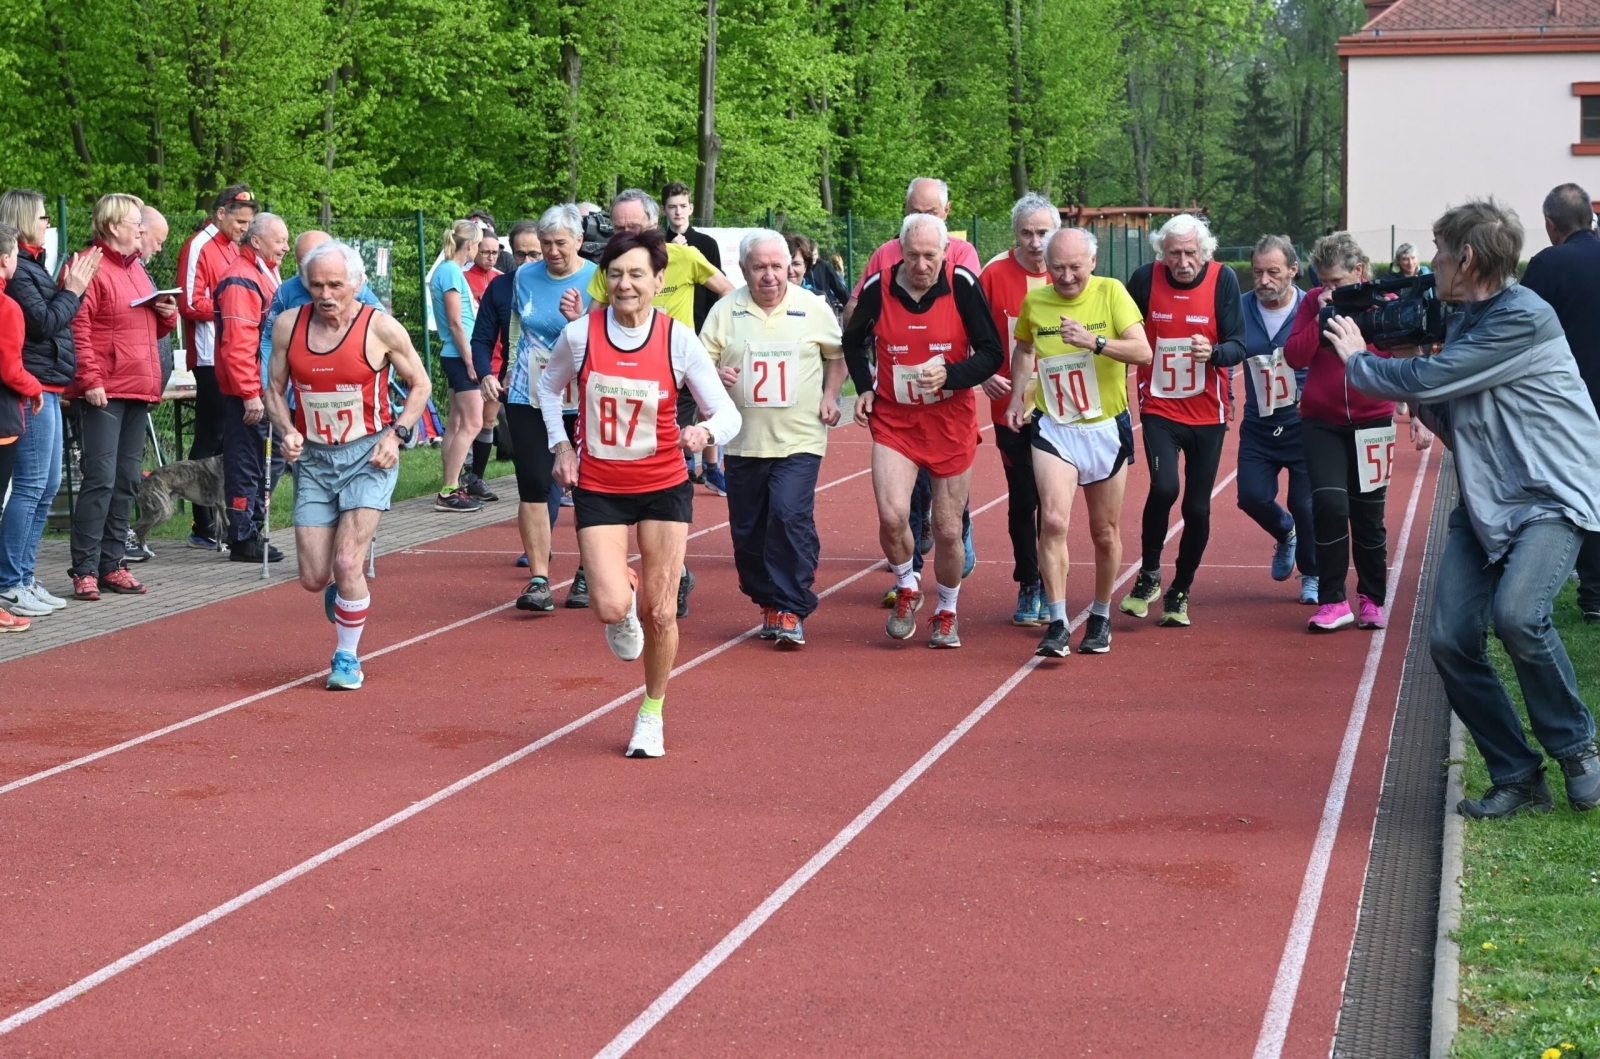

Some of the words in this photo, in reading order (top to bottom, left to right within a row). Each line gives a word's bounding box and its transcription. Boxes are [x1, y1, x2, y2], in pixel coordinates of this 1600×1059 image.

[750, 350, 770, 358] PIVOVAR
[1158, 345, 1177, 353] PIVOVAR
[1045, 365, 1064, 374] PIVOVAR
[1064, 361, 1087, 371] TRUTNOV
[1162, 352, 1196, 392] 53
[594, 383, 619, 395] PIVOVAR
[620, 387, 649, 398] TRUTNOV
[753, 360, 786, 403] 21
[1048, 369, 1090, 417] 70
[330, 400, 354, 409] TRUTNOV
[314, 409, 353, 446] 42
[600, 396, 644, 448] 87
[1364, 436, 1384, 444] PIVOVAR
[1366, 442, 1395, 484] 58
